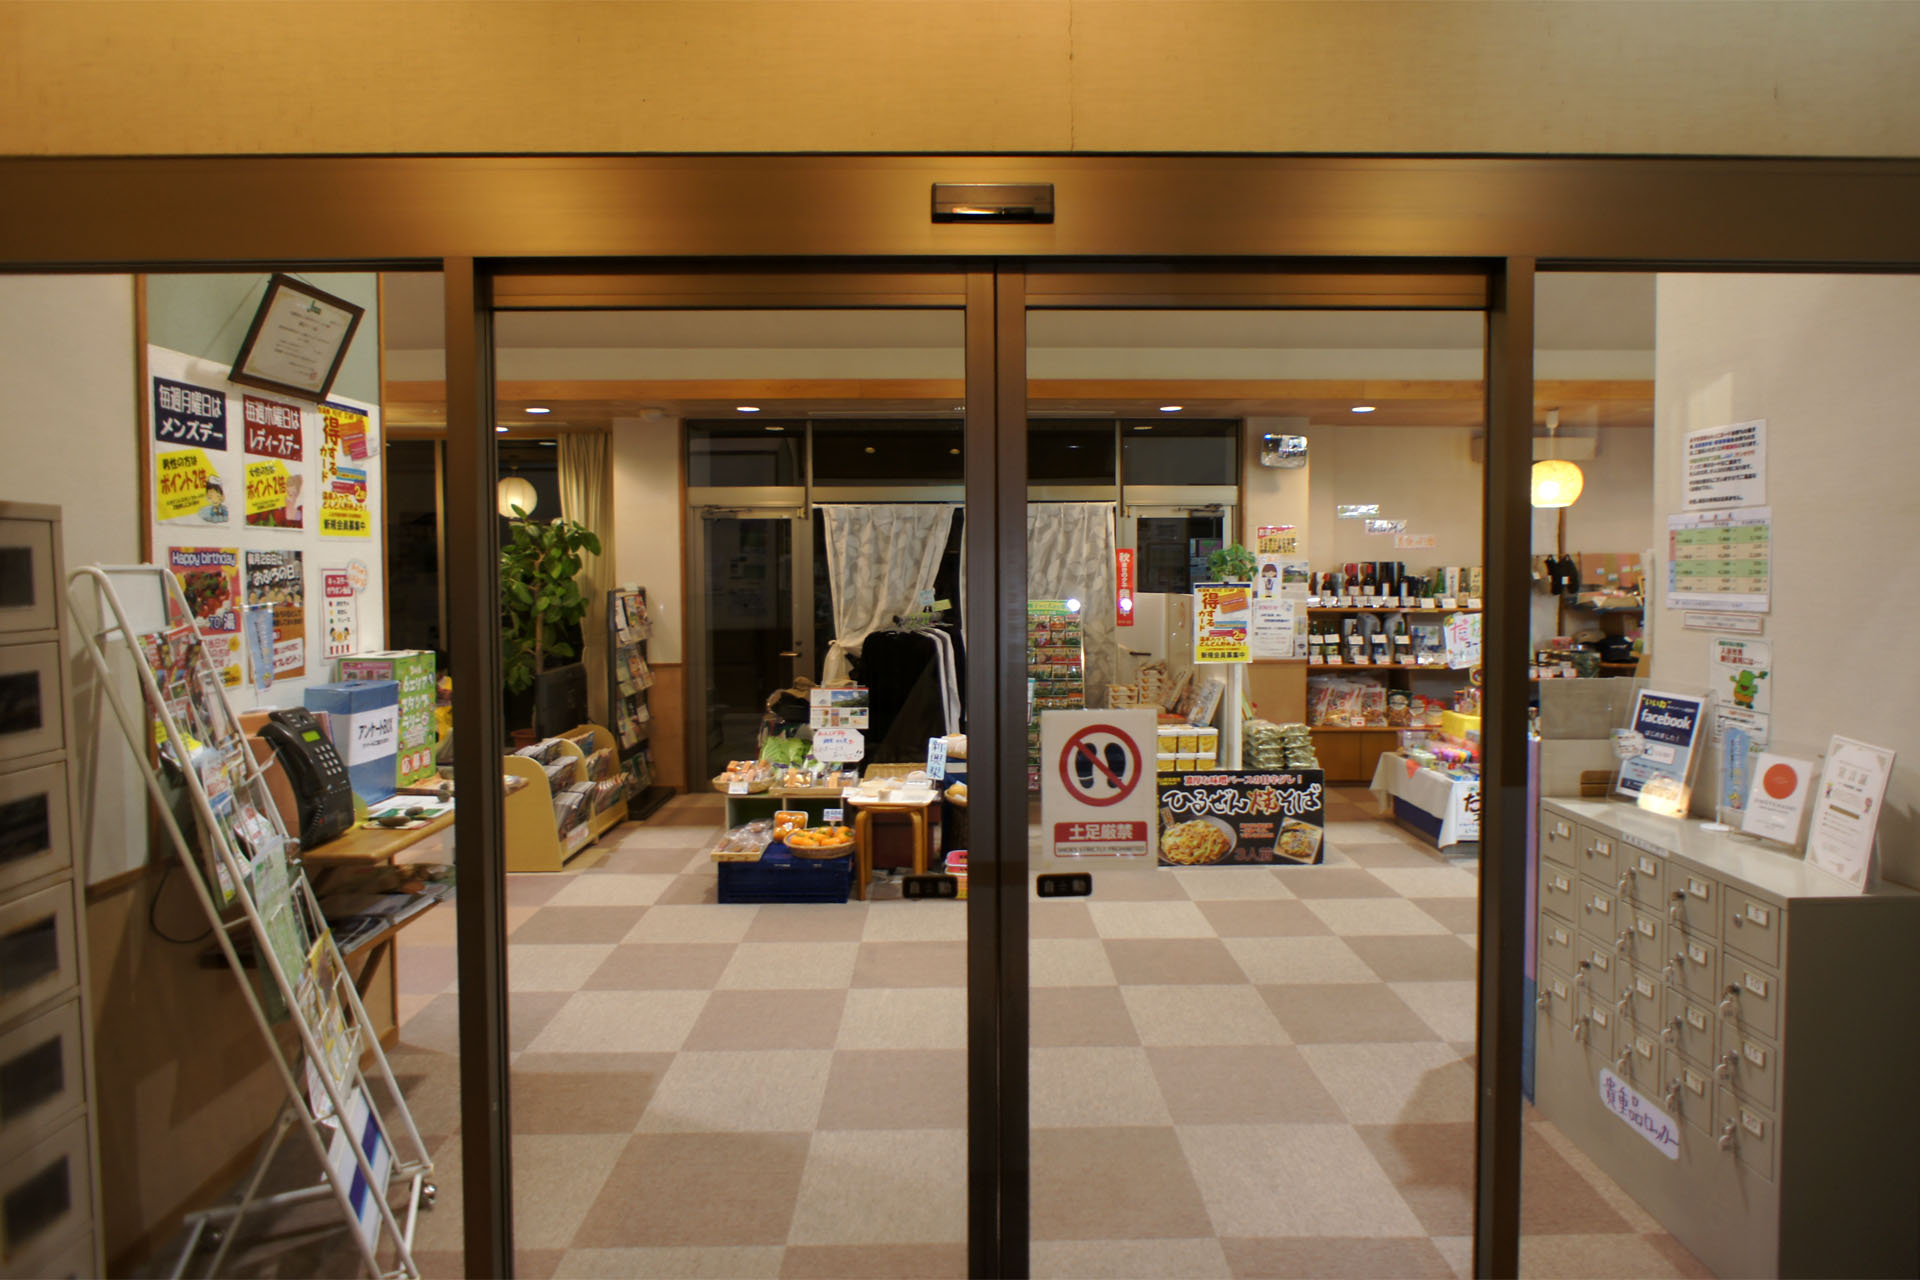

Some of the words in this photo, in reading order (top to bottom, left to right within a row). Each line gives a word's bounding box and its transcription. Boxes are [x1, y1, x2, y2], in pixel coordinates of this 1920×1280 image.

[159, 384, 223, 418] 毎週月曜日は
[246, 401, 300, 430] 毎週木曜日は
[160, 418, 224, 442] メンズデー
[250, 428, 301, 455] レディースデー
[172, 551, 200, 566] Happy
[201, 551, 236, 567] birthday
[1641, 709, 1692, 729] facebook
[1163, 784, 1322, 815] ひるぜん焼そば
[1069, 823, 1133, 840] 土足厳禁
